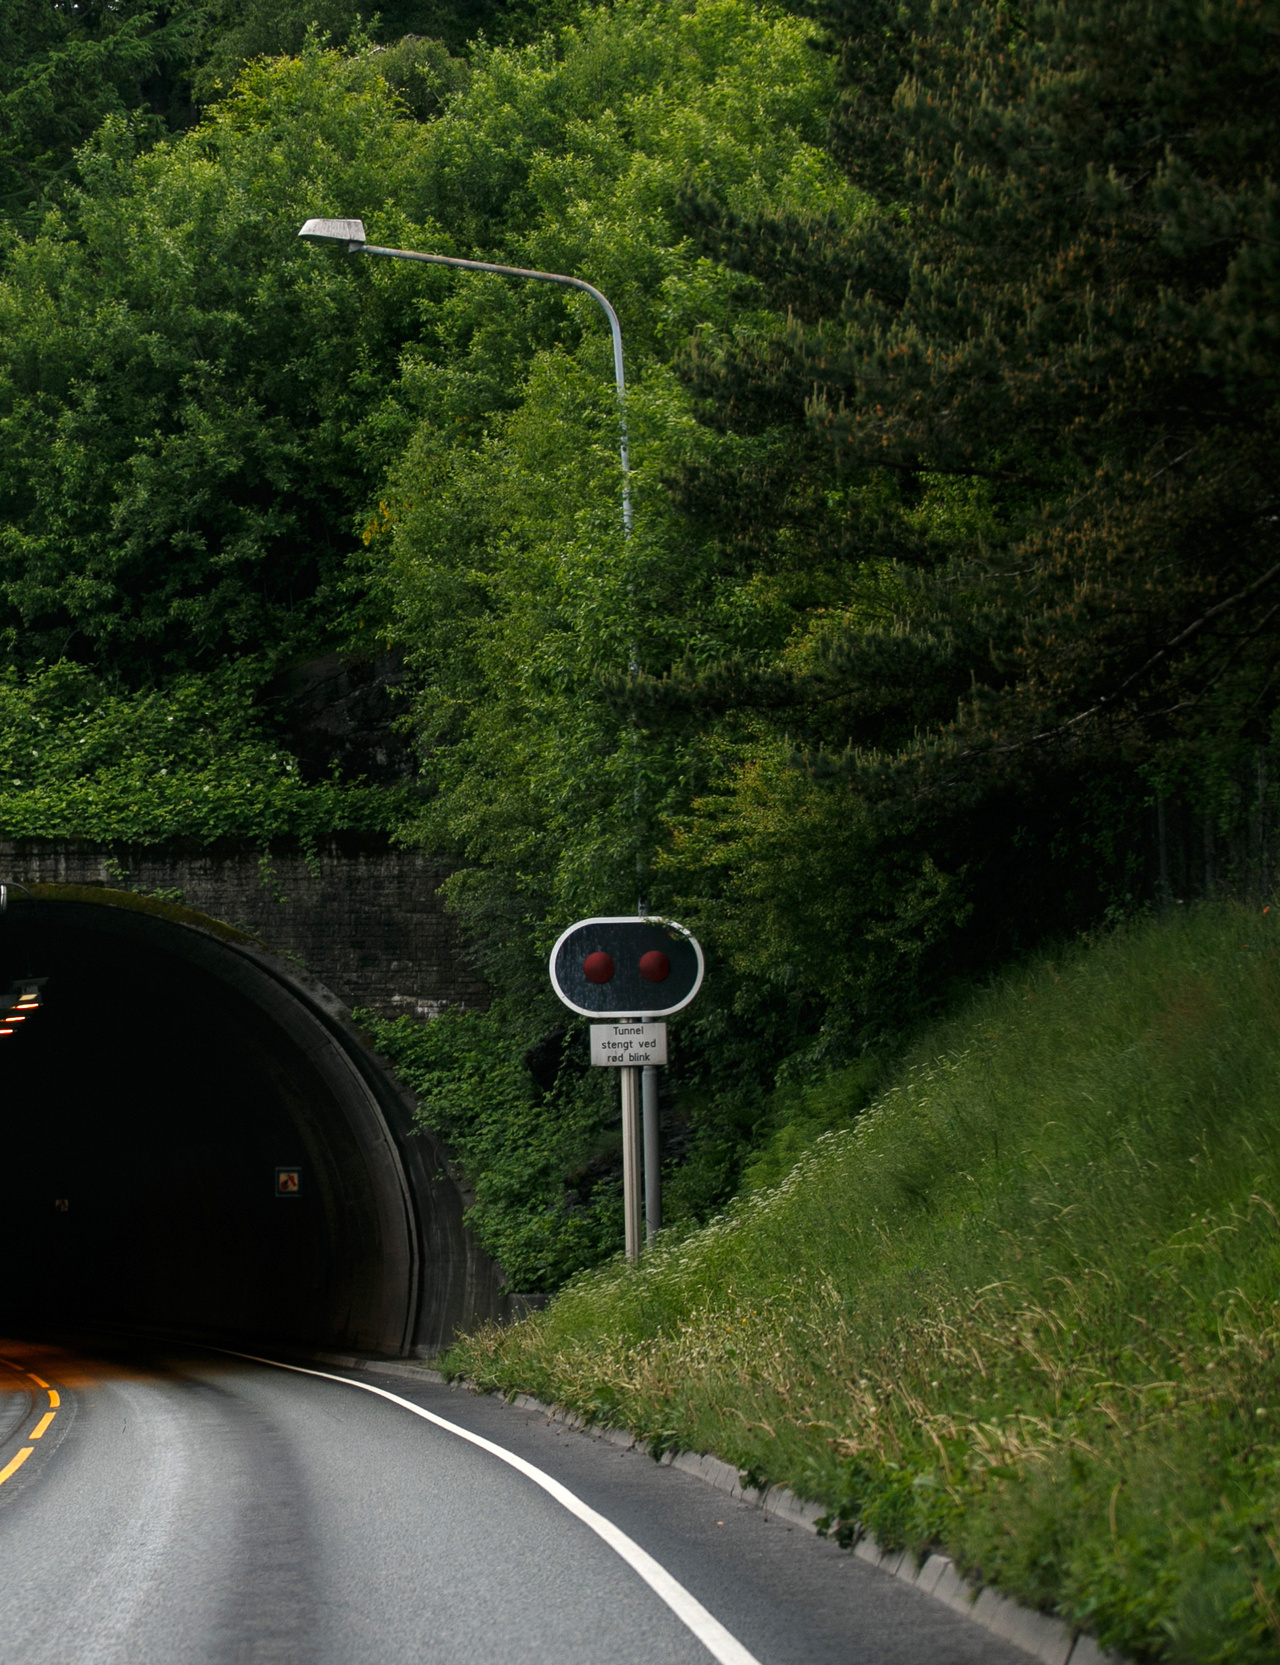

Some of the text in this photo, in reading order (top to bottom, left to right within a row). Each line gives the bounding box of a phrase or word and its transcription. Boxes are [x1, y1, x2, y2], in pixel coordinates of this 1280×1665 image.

[613, 1026, 644, 1035] Tunnel
[601, 1039, 657, 1050] stengt ved
[607, 1052, 650, 1062] rød blink
